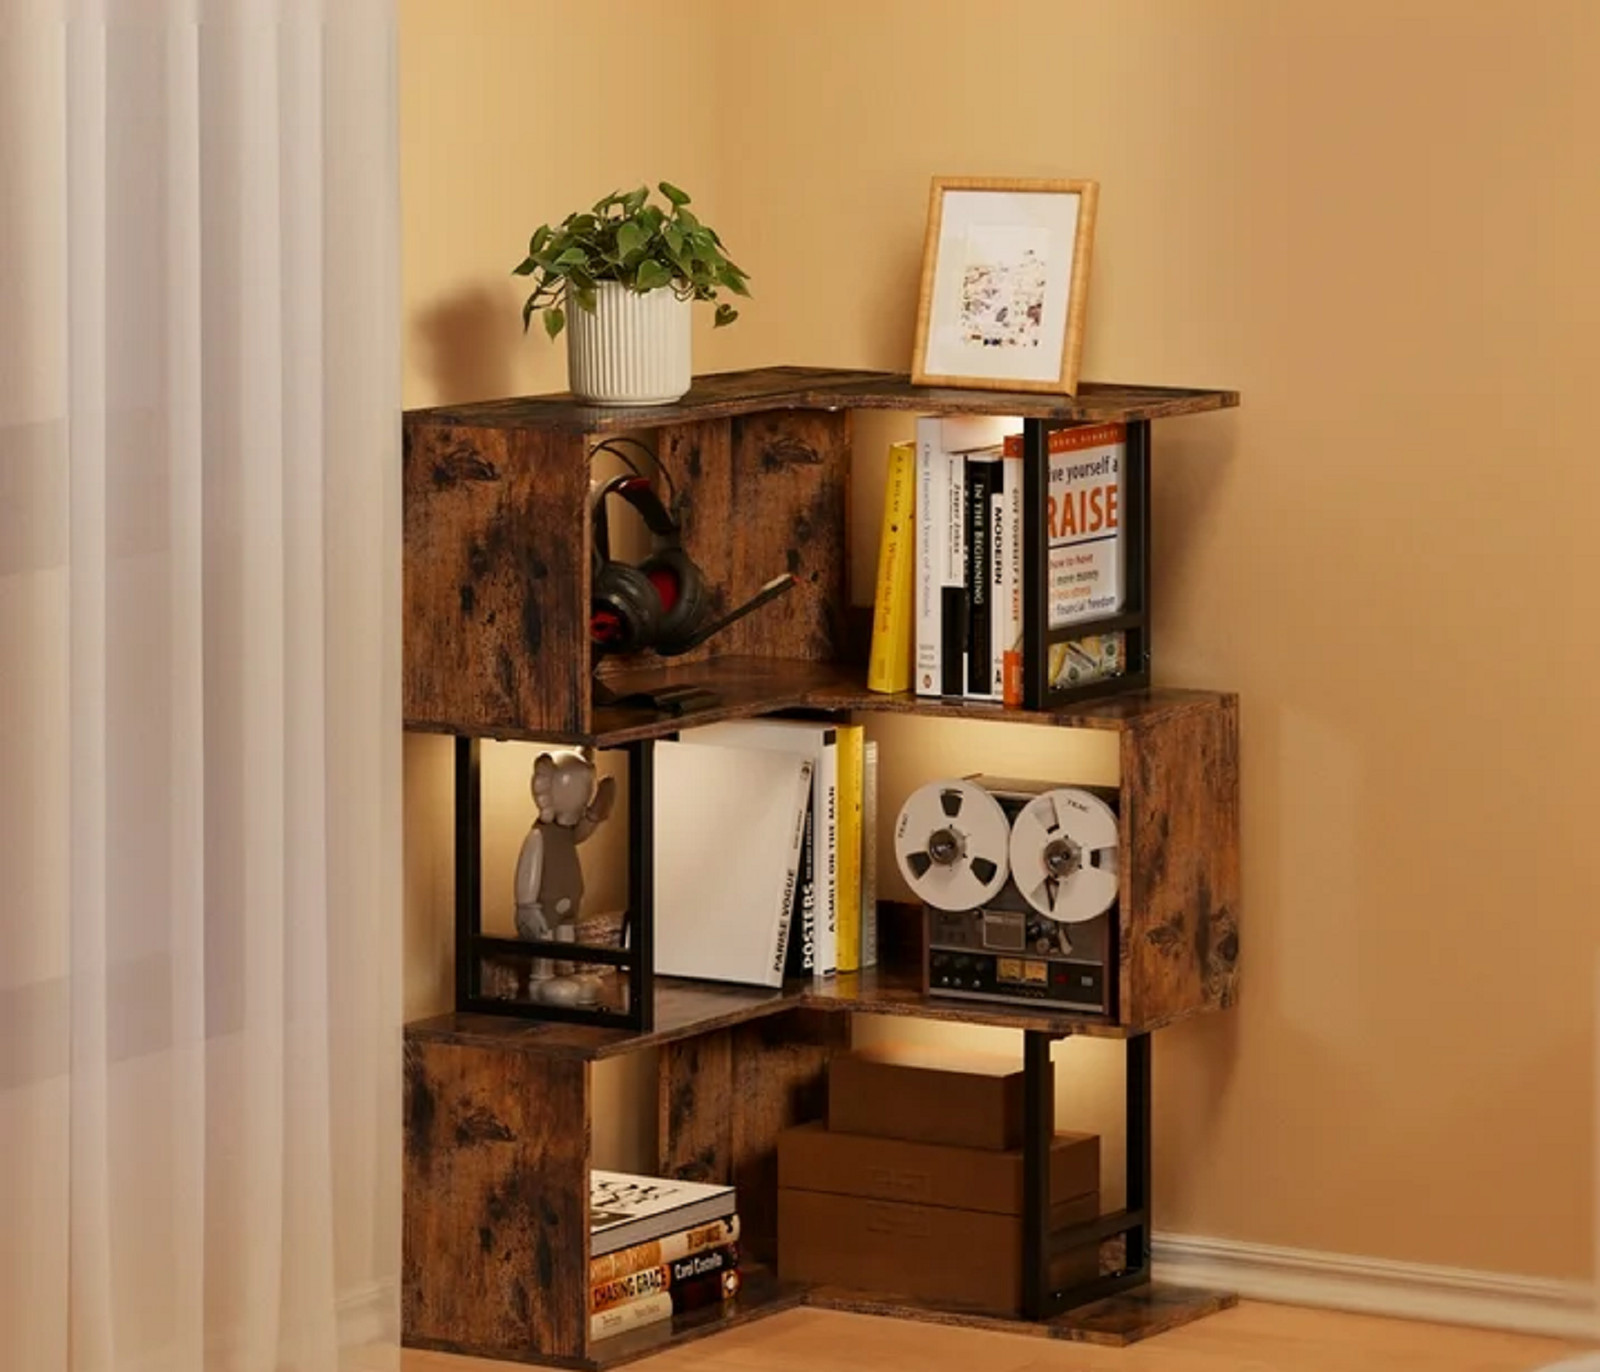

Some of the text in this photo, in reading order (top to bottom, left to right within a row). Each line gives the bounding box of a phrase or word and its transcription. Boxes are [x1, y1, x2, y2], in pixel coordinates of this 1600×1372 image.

[1066, 456, 1111, 485] yourself
[1113, 459, 1118, 473] a
[973, 503, 985, 527] THE
[1048, 484, 1118, 538] RAISE
[973, 530, 985, 605] BEGINNING
[994, 506, 1003, 585] MODERN
[781, 869, 796, 917] VOGUE
[802, 881, 814, 969] POSTERS
[593, 1265, 668, 1308] CHASING GRACE
